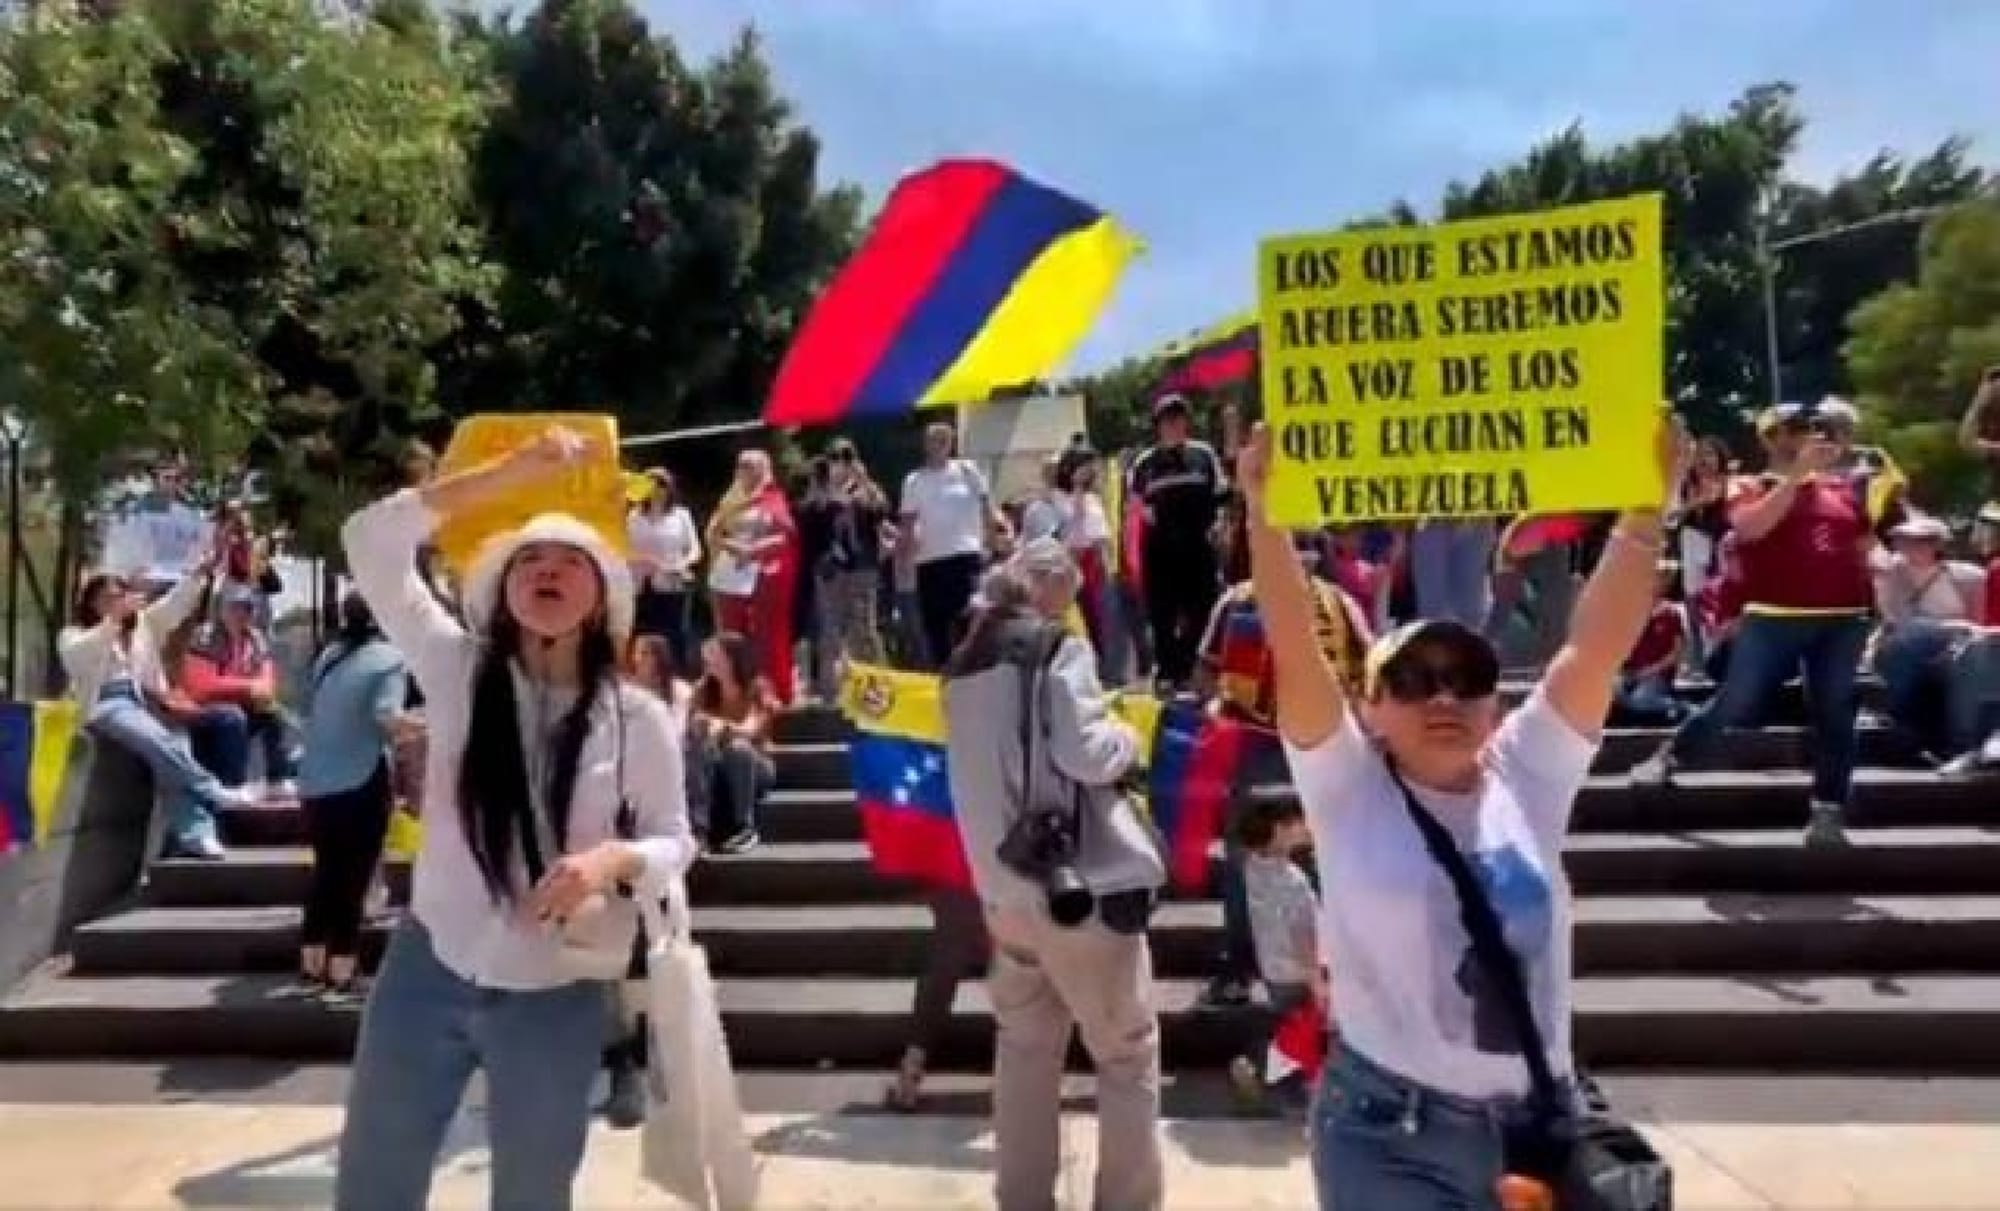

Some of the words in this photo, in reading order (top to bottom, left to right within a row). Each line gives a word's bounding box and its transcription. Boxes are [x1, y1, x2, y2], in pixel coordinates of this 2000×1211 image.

[1276, 247, 1340, 292] LOS
[1362, 240, 1435, 285] QUE
[1456, 219, 1638, 277] ESTAMOS
[1279, 300, 1422, 348] AFUERA
[1436, 278, 1622, 336] SEREMOS
[1282, 365, 1328, 405] LA
[1348, 358, 1415, 402] VOZ
[1440, 354, 1490, 395] DE
[1508, 348, 1579, 391] LOS
[1282, 420, 1355, 463] QUE
[1380, 408, 1525, 456] LUCHAN
[1543, 406, 1591, 448] EN
[1316, 469, 1529, 515] VENEZUELA
